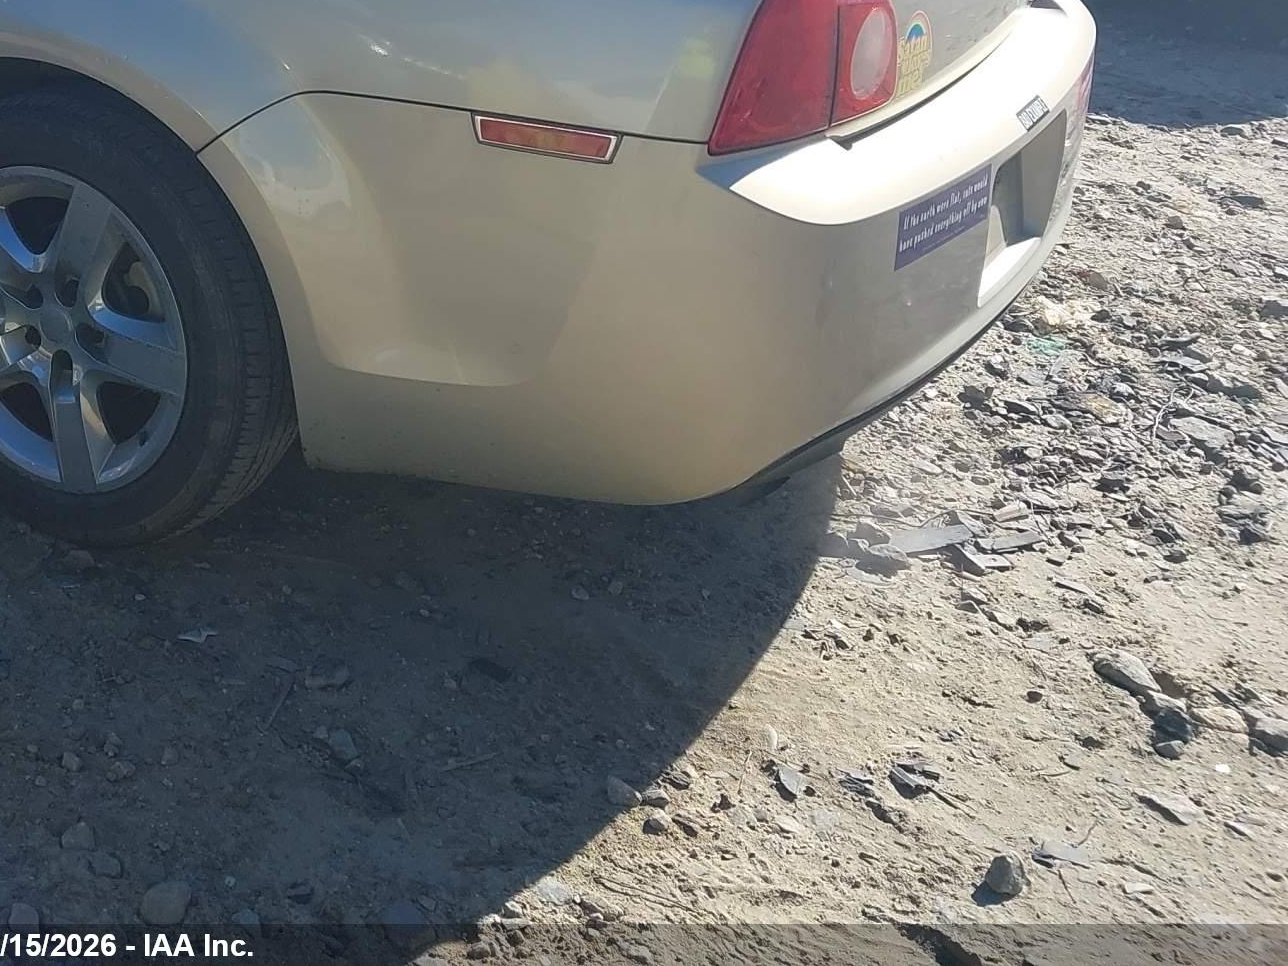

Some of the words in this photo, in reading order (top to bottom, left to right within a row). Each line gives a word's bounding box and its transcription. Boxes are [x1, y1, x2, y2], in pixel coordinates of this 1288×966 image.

[899, 239, 913, 253] have
[913, 223, 934, 249] pushed
[934, 211, 962, 232] everything
[963, 201, 971, 217] off
[971, 199, 977, 215] by
[910, 213, 920, 227] the
[920, 204, 935, 222] earth
[936, 199, 949, 213] were
[973, 172, 988, 191] would
